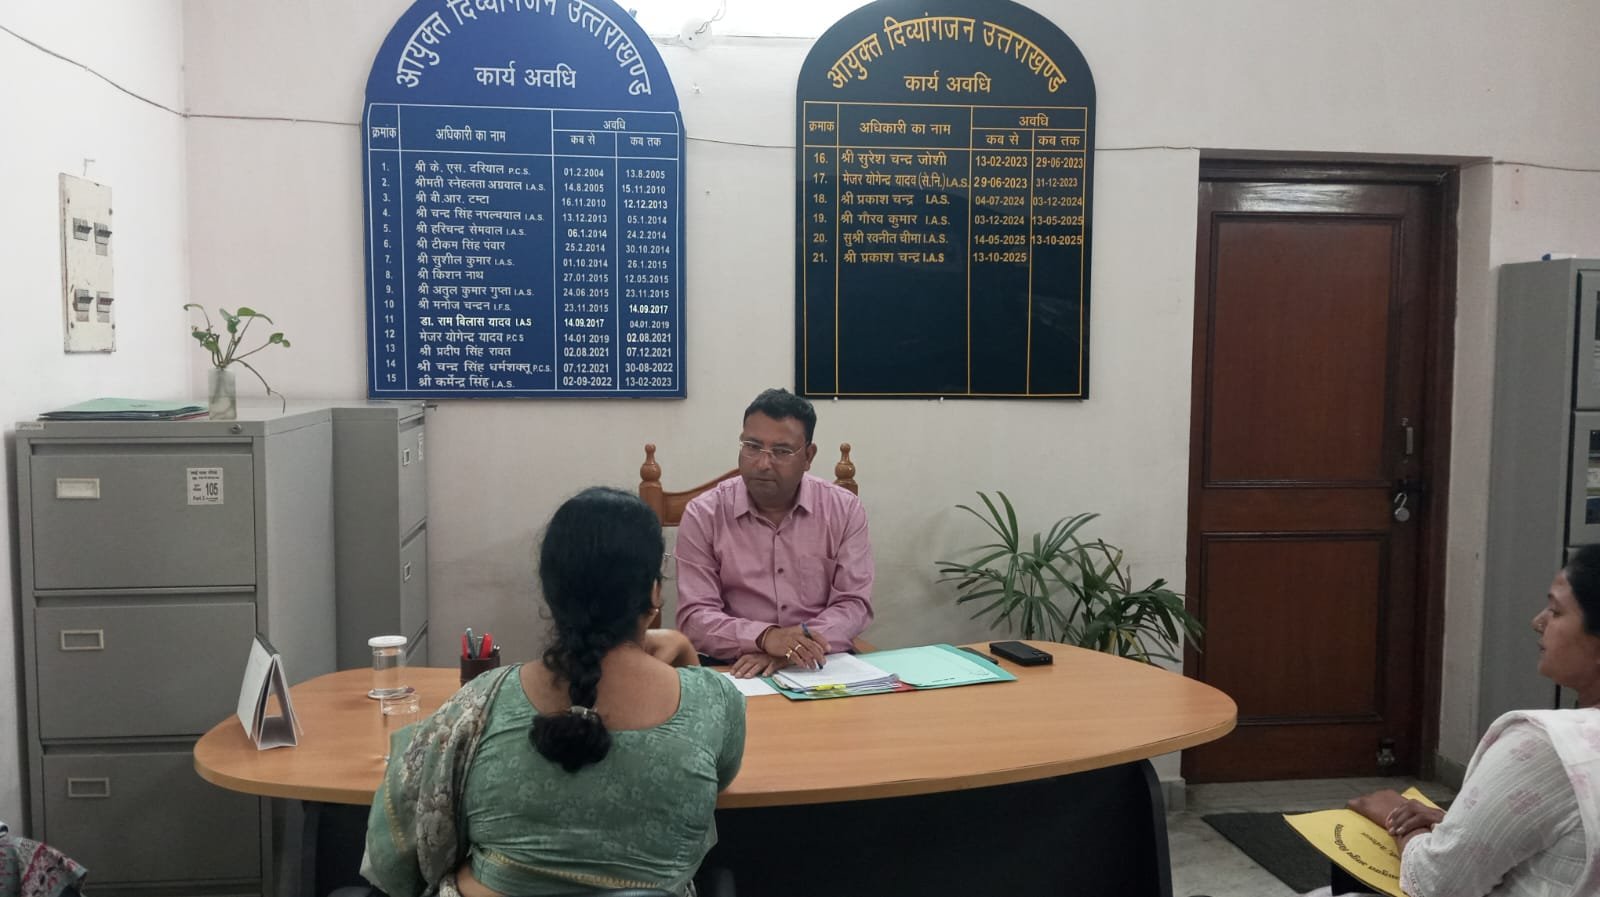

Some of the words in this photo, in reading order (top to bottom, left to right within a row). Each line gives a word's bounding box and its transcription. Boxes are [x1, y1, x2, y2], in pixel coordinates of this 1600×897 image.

[396, 11, 451, 87] आयुक्त
[828, 33, 883, 88] आयुक्त
[884, 12, 975, 50] दिव्यांगजन
[983, 20, 1067, 92] उत्तराखण्ड
[474, 61, 515, 86] कार्य
[524, 63, 576, 88] अवधि
[904, 70, 939, 91] कार्य
[946, 72, 991, 92] अवधि
[603, 118, 625, 130] अवधि
[1019, 113, 1048, 126] अवधि
[860, 119, 906, 134] अधिकारी
[911, 124, 925, 134] का
[930, 124, 951, 134] नाम
[436, 125, 472, 140] अधिकारी
[475, 130, 486, 141] का
[490, 131, 505, 142] नाम
[587, 133, 595, 144] से
[1008, 132, 1019, 145] से
[647, 137, 661, 146] तक
[1061, 136, 1080, 146] तक
[814, 153, 828, 163] 16.
[841, 149, 854, 163] श्री
[857, 151, 885, 168] सुरेश
[917, 151, 946, 165] जोशी
[976, 156, 1027, 167] 13-02-2023
[1036, 157, 1083, 168] 29-06-2023
[382, 162, 389, 171] 1.
[415, 160, 426, 172] श्री
[469, 161, 504, 173] दरियाल
[564, 168, 604, 177] 01.2.2004
[626, 170, 665, 179] 13.8.2005
[382, 178, 389, 186] 2.
[415, 176, 443, 187] श्रीमती
[813, 173, 827, 184] 17.
[842, 171, 862, 184] मेजर
[895, 175, 916, 186] यादव
[974, 177, 1027, 188] 29-06-2023
[1036, 178, 1077, 187] 31-12-2023
[565, 183, 604, 192] 14.8.2005
[622, 184, 665, 194] 15.11.2010
[383, 193, 390, 201] 3.
[416, 191, 426, 202] श्री
[813, 194, 827, 203] 18.
[841, 191, 853, 204] श्री
[857, 195, 889, 204] प्रकाश
[976, 196, 1024, 205] 04-07-2024
[1032, 196, 1082, 206] 03-12-2024
[562, 198, 606, 207] 16.11.2010
[624, 200, 667, 209] 12.12.2013
[383, 208, 390, 216] 4.
[416, 206, 427, 217] श्री
[455, 207, 472, 219] सिंह
[563, 213, 607, 223] 13.12.2013
[628, 216, 666, 224] 05.1.2014
[813, 213, 826, 223] 19.
[840, 210, 853, 224] श्री
[888, 215, 917, 228] कुमार
[975, 215, 1024, 225] 03-12-2024
[1032, 215, 1084, 226] 13-05-2025
[384, 224, 391, 232] 5.
[416, 221, 427, 233] श्री
[568, 229, 607, 238] 06.1.2014
[627, 230, 666, 239] 24.2.2014
[813, 233, 827, 242] 20.
[843, 230, 864, 246] सुश्री
[867, 230, 897, 243] रवनीत
[900, 230, 921, 243] चीमा
[384, 240, 391, 248] 6.
[417, 237, 427, 248] श्री
[432, 238, 458, 249] टीकम
[462, 238, 480, 251] सिंह
[975, 235, 1025, 244] 14-05-2025
[1031, 235, 1082, 245] 13-10-2025
[565, 243, 605, 252] 25.2.2014
[626, 245, 670, 254] 30.10.2014
[385, 255, 391, 263] 7.
[417, 252, 428, 264] श्री
[432, 253, 462, 268] सुशील
[466, 256, 491, 268] कुमार
[813, 253, 827, 262] 21.
[844, 249, 856, 263] श्री
[860, 253, 894, 263] प्रकाश
[973, 252, 1027, 262] 13-10-2025
[563, 259, 608, 267] 01.10.2014
[628, 260, 667, 268] 26.1.2015
[417, 267, 428, 279] श्री
[564, 273, 608, 282] 27.01.2015
[625, 275, 668, 283] 12.05.2015
[418, 283, 428, 294] श्री
[433, 286, 457, 299] अतुल
[461, 286, 486, 298] कुमार
[563, 288, 608, 297] 24.06.2015
[626, 289, 669, 298] 23.11.2015
[384, 300, 394, 308] 10
[418, 297, 429, 309] श्री
[433, 298, 460, 310] मनोज
[565, 304, 608, 312] 23.11.2015
[629, 305, 668, 314] 14.09.2017
[385, 315, 393, 323] 11
[438, 317, 452, 326] राम
[488, 318, 511, 327] यादव
[565, 318, 604, 327] 14.09.2017
[385, 330, 395, 338] 12
[419, 329, 442, 342] मेजर
[479, 333, 502, 342] यादव
[627, 333, 670, 342] 02.08.2021
[386, 344, 395, 352] 13
[420, 344, 431, 356] श्री
[436, 344, 460, 356] प्रदीप
[466, 345, 483, 357] सिंह
[489, 348, 511, 356] रावत
[564, 347, 608, 357] 02.08.2021
[627, 347, 671, 357] 07.12.2021
[417, 360, 430, 371] श्री
[464, 360, 484, 372] सिंह
[564, 364, 608, 373] 07.12.2021
[625, 363, 673, 372] 30-08-2022
[387, 374, 396, 382] 15
[419, 374, 431, 386] श्री
[469, 375, 489, 387] सिंह
[563, 376, 612, 386] 02-09-2022
[626, 377, 671, 386] 13-02-2023
[206, 483, 218, 496] 105
